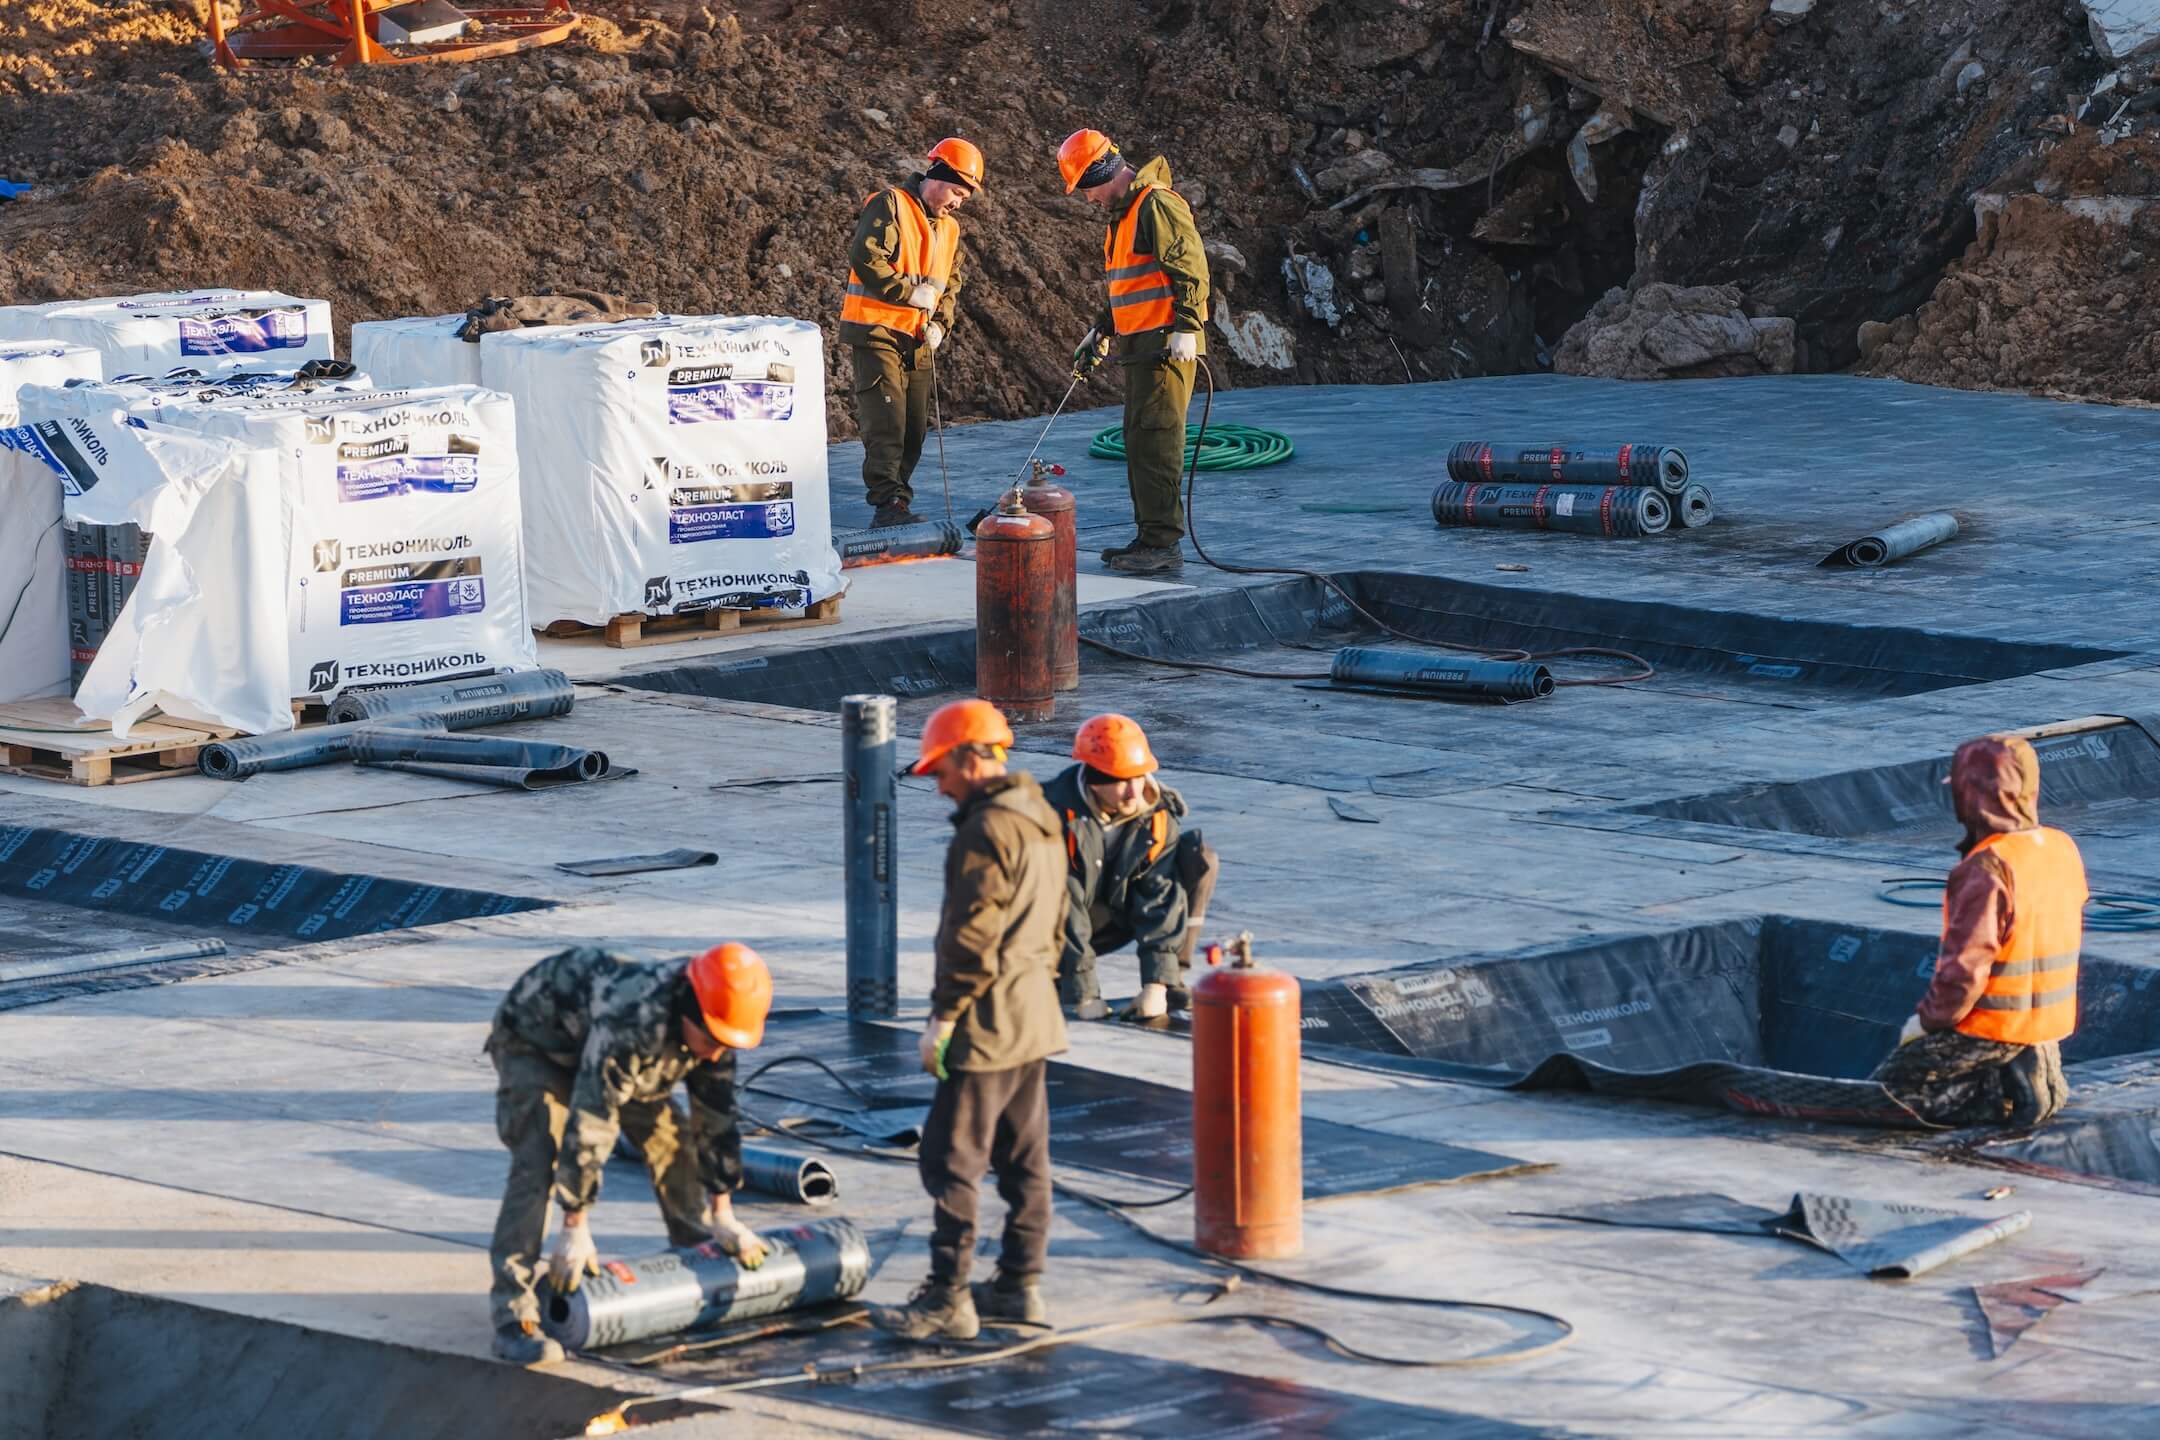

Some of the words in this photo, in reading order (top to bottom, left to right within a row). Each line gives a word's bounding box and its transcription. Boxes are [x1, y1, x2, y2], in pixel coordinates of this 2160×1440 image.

[677, 367, 732, 383] PREMIUM
[66, 417, 110, 466] НИКОЛЬ
[343, 438, 406, 458] PREMIUM
[1523, 453, 1566, 464] PREMI
[676, 489, 732, 502] PREMIUM
[1505, 489, 1596, 501] ТЕХННИОЛЬ
[676, 510, 745, 524] ТЕХНОЭЛАСТ
[1504, 508, 1545, 518] PREMI
[345, 534, 473, 560] ТЕХНОНИКОЛЬ
[848, 541, 886, 555] PREMIUM
[349, 566, 410, 584] PREMIUM
[675, 572, 798, 593] ТЕХНОНИКОЛЬ
[87, 570, 97, 613] PREMIU
[113, 569, 121, 615] PREMIU
[346, 588, 425, 605] ТЕХНОЭЛАСТ
[343, 652, 486, 677] ТЕХНОНИКОЛЬ
